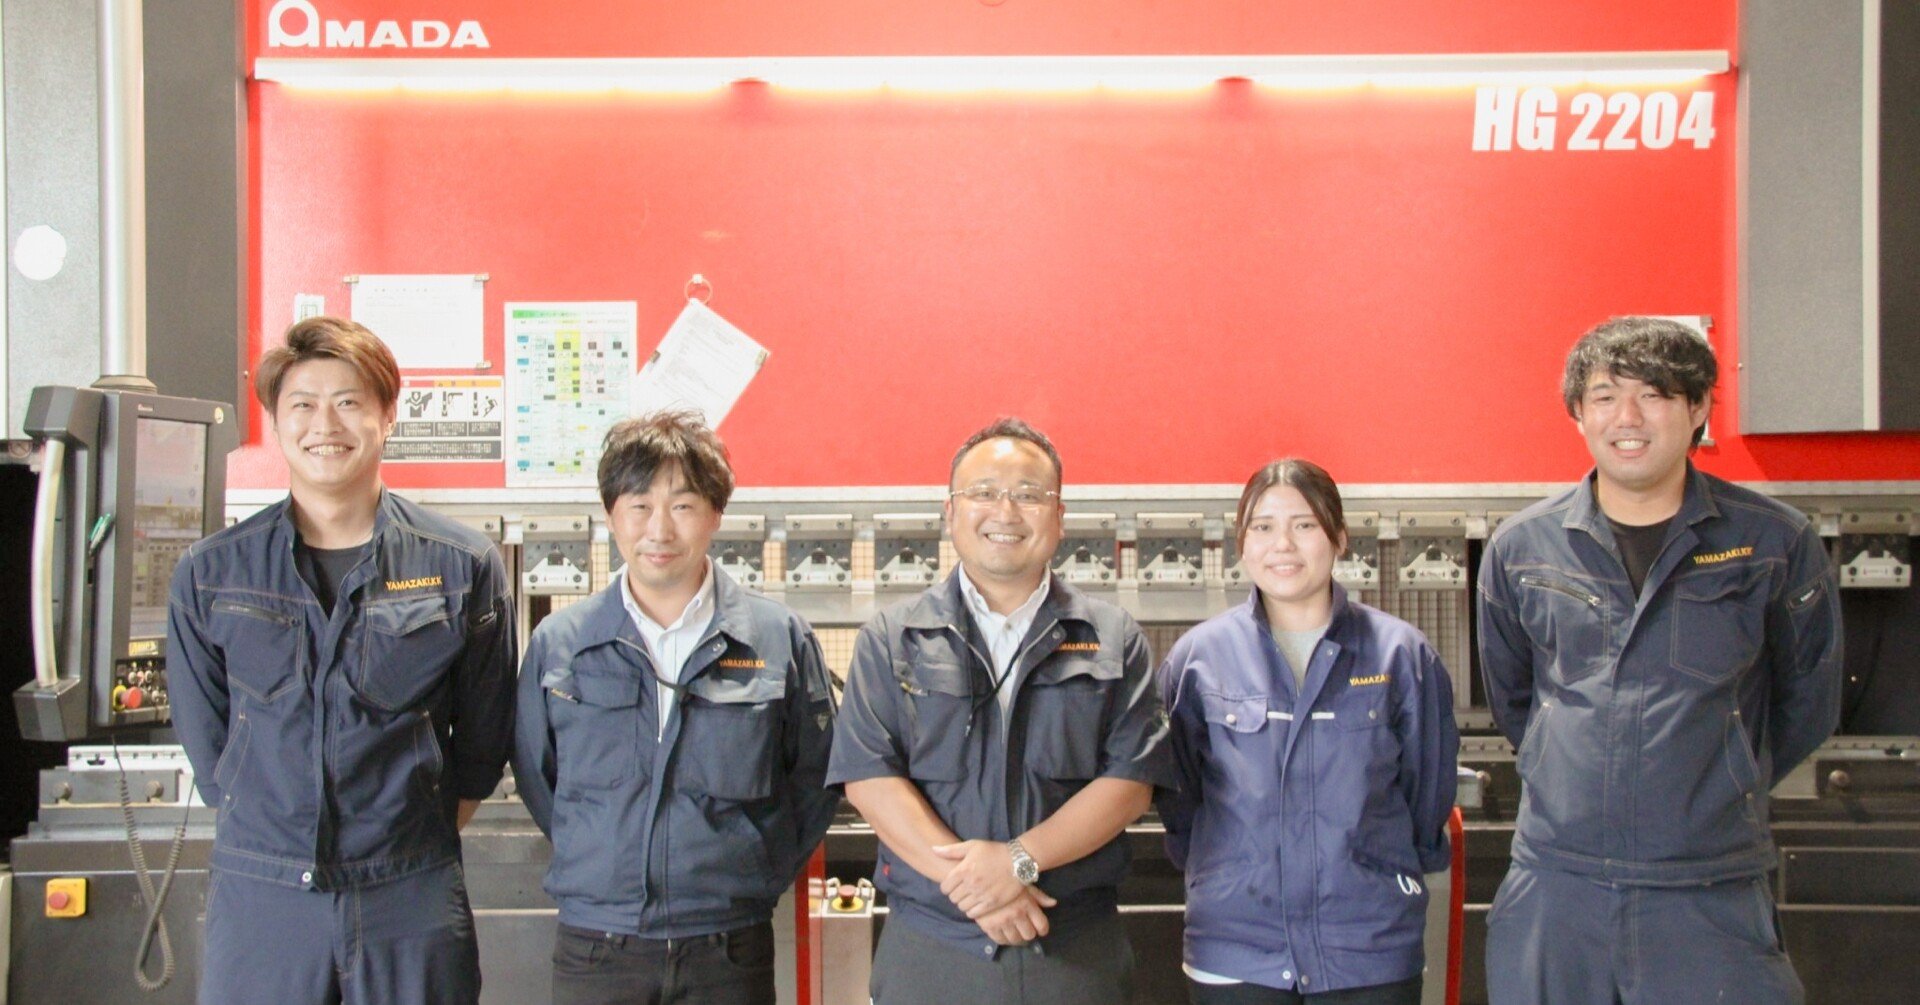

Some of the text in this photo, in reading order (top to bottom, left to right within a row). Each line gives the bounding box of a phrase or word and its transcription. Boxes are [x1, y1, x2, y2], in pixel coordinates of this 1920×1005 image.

[267, 0, 490, 48] AMADA
[1472, 86, 1716, 151] HG 2204
